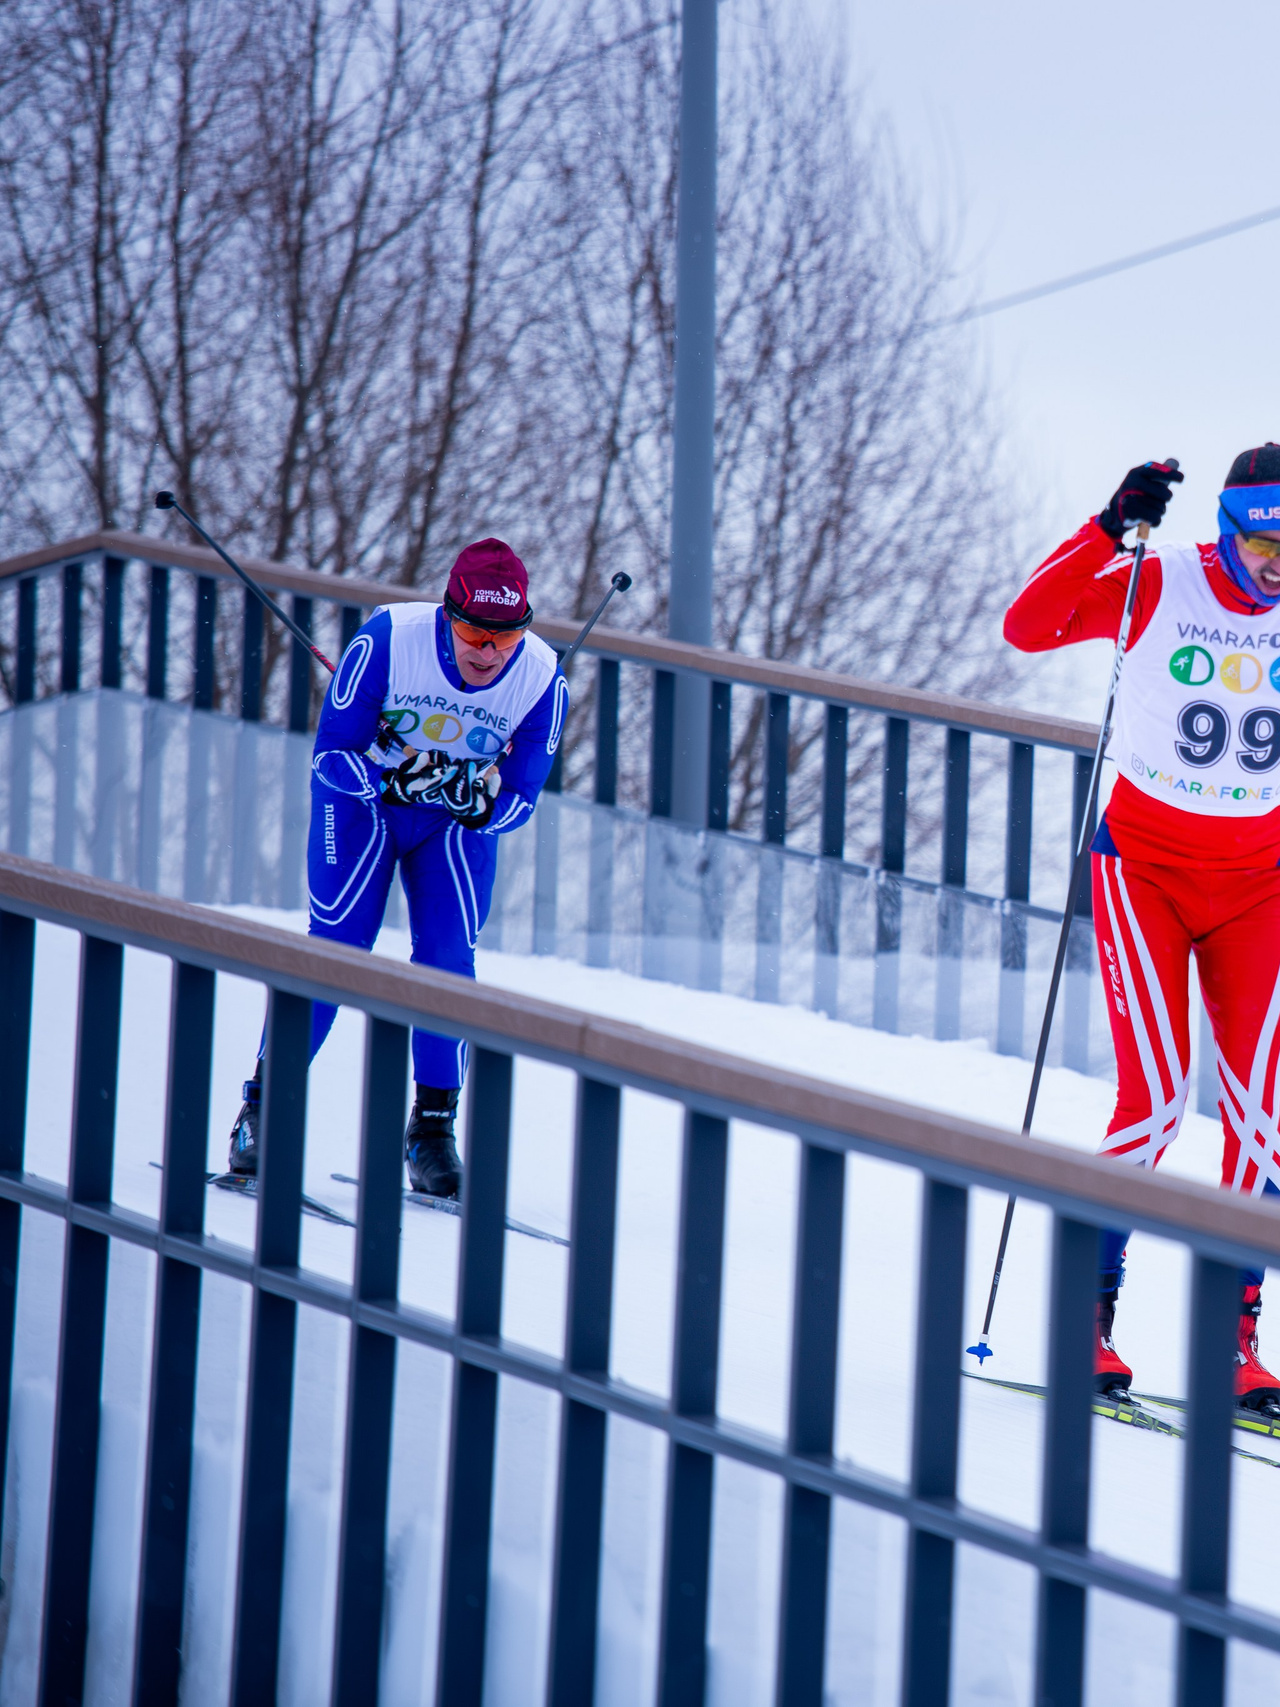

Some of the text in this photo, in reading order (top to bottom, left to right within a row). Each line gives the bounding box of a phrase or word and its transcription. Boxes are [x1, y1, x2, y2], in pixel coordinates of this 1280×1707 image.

[473, 595, 516, 607] ЛЕГКОВА
[475, 589, 501, 597] ГОНКА
[394, 693, 508, 732] VMARAFONE
[324, 804, 337, 865] noname
